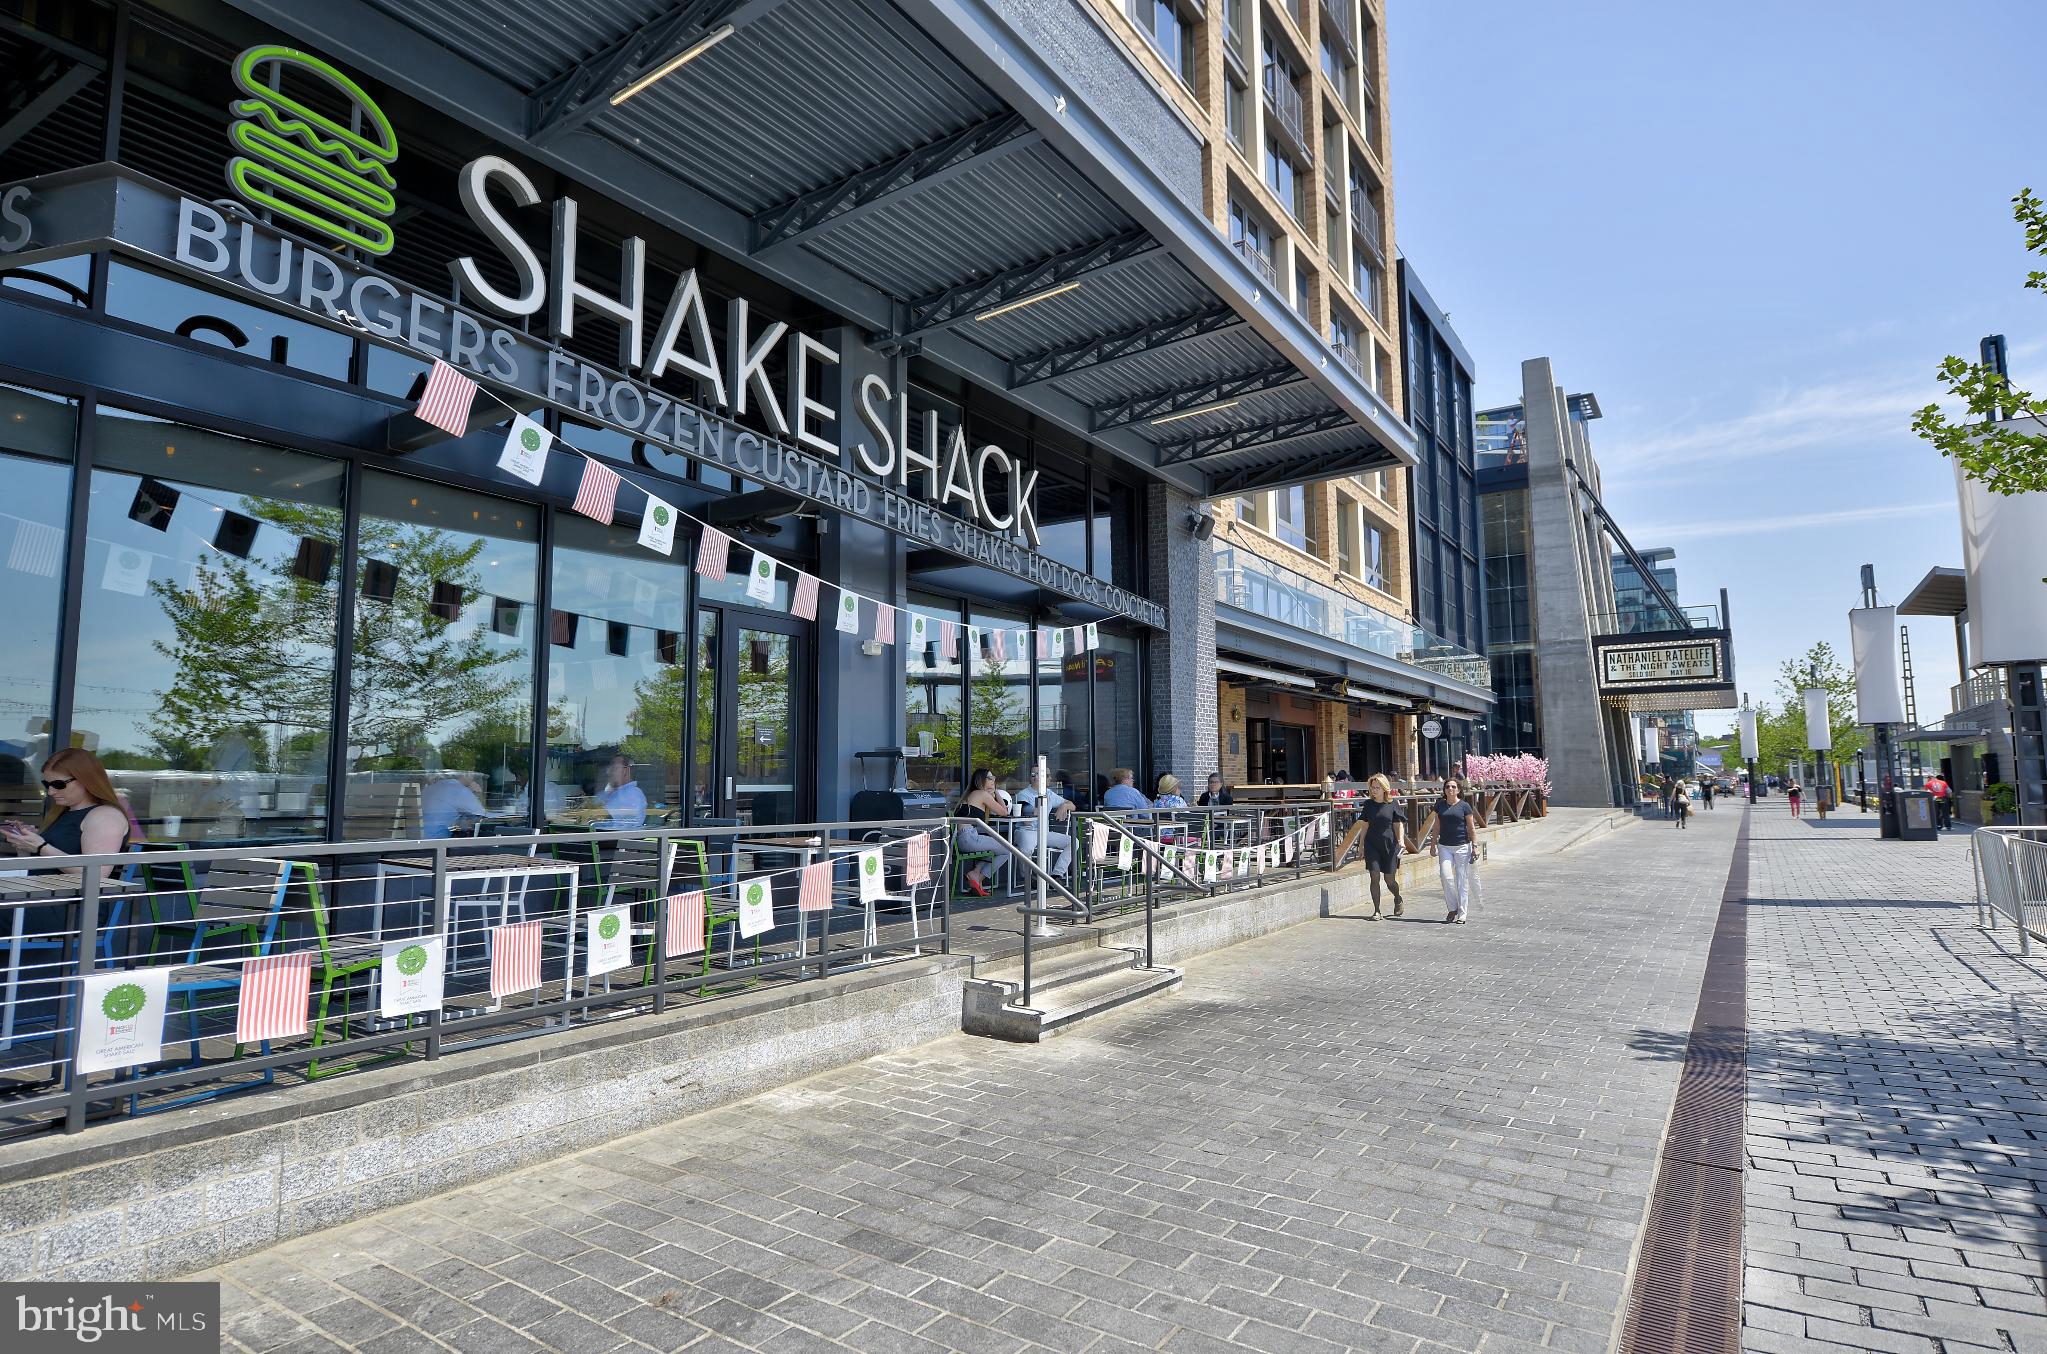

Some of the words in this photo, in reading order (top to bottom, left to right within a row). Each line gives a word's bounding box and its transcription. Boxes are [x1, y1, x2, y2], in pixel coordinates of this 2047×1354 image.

[176, 196, 519, 384] BURGERS
[548, 351, 724, 462] FROZEN
[735, 434, 870, 514] CUSTARD
[884, 491, 942, 544] FRIES
[953, 522, 1021, 574] SHAKES
[1028, 553, 1060, 589] HOT
[1062, 568, 1098, 601] DOGS
[1105, 585, 1166, 630] CONCRETES
[448, 155, 839, 455] SHAKE
[850, 374, 1040, 545] SHACK
[1609, 651, 1662, 664] NATHANIEL
[1666, 649, 1710, 660] RATELIFF
[1641, 662, 1667, 670] NIGHT
